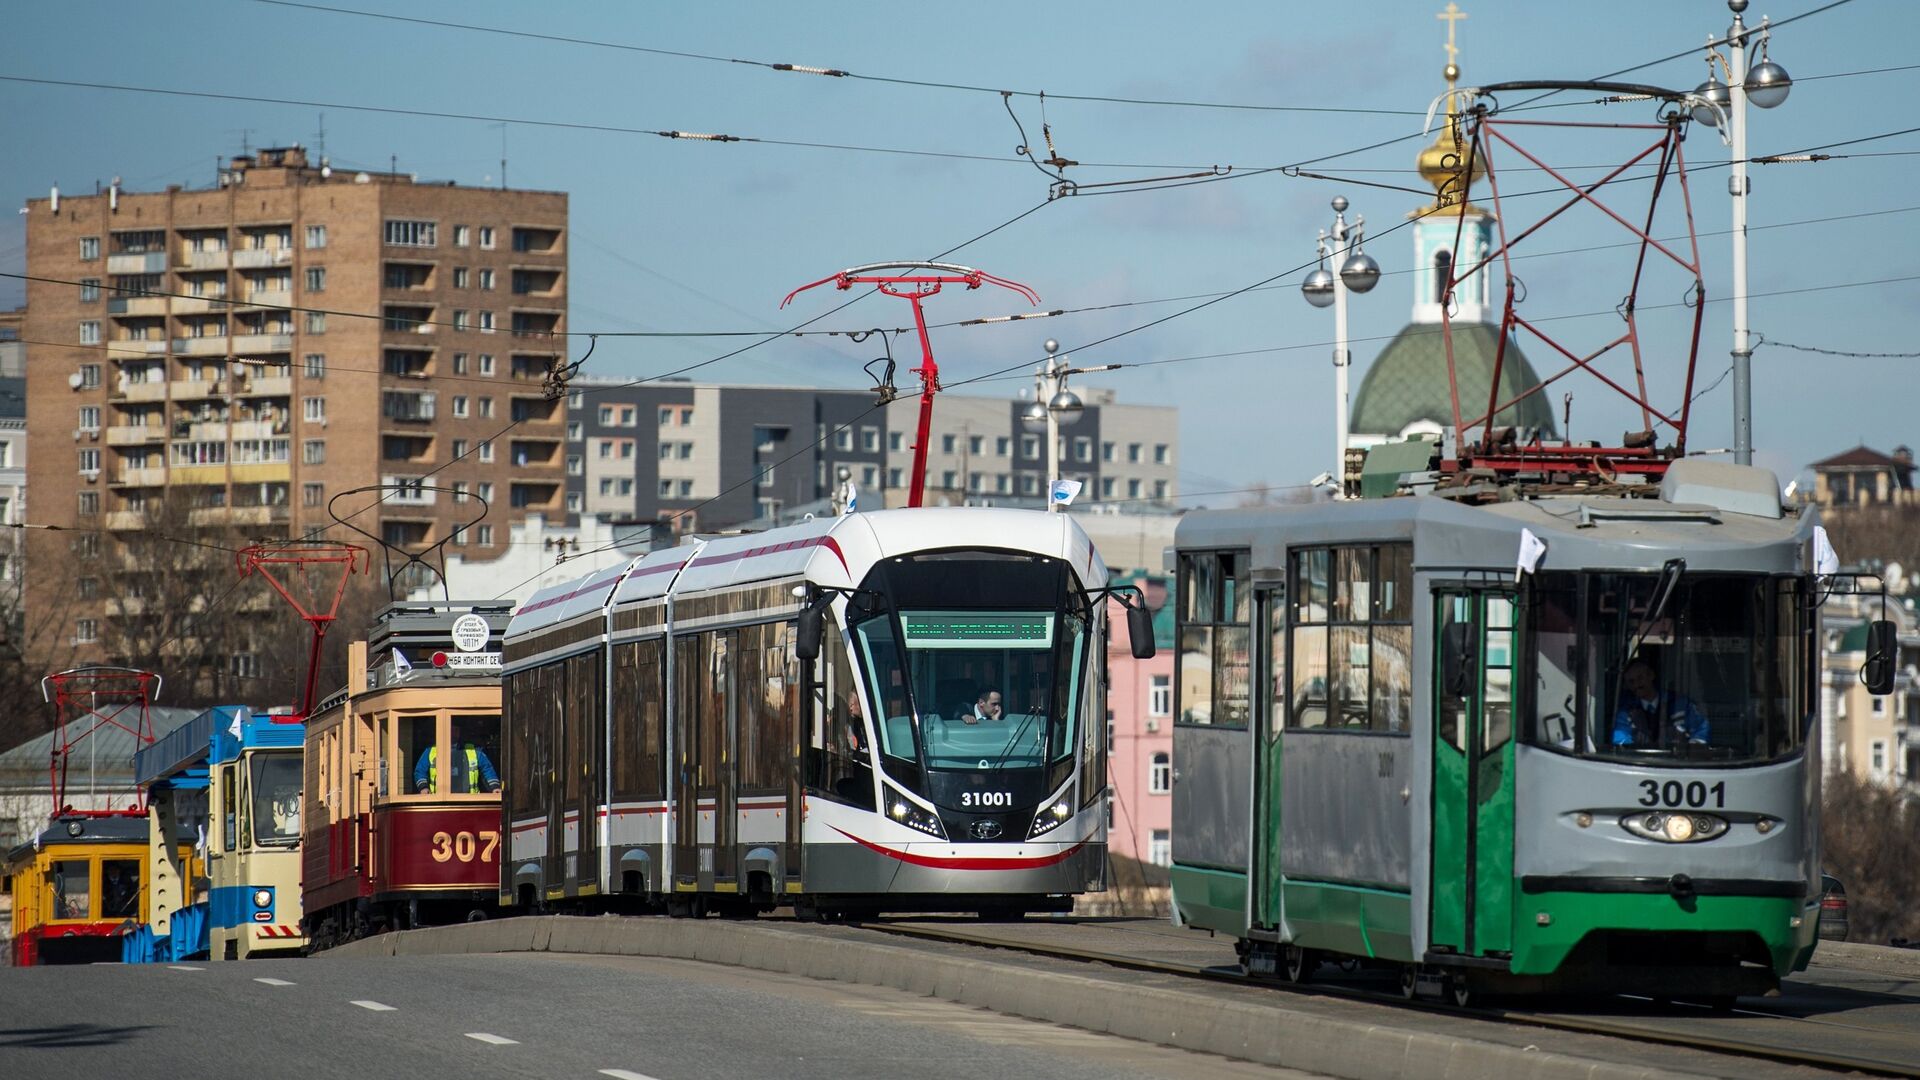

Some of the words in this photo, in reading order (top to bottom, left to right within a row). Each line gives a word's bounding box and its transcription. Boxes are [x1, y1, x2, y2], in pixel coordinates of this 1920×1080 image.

[961, 792, 1012, 806] 31001
[1638, 779, 1725, 808] 3001
[432, 831, 499, 862] 307
